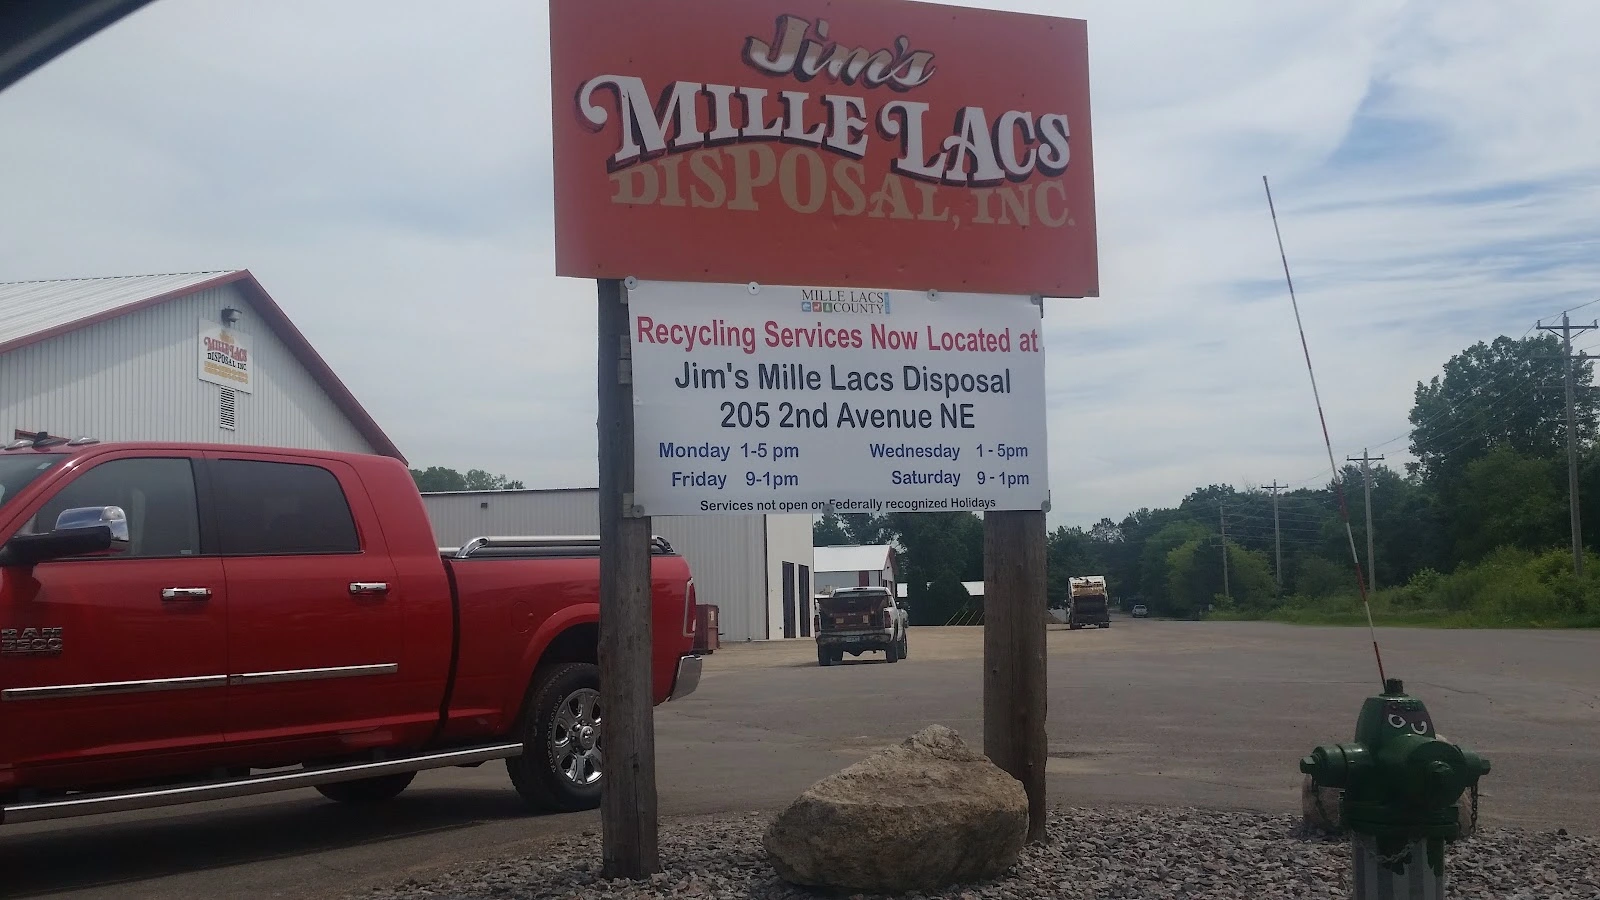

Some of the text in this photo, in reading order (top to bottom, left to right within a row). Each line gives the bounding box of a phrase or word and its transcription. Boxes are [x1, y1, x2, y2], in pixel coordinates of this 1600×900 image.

[742, 14, 936, 91] Jim's
[577, 74, 1073, 186] MILLE LACS
[972, 179, 1076, 228] INC.
[802, 289, 846, 302] MILLE
[850, 291, 884, 304] LACS
[833, 302, 884, 314] COUNTY
[637, 316, 1039, 354] Recycling Services Now Located at
[674, 362, 1011, 398] Jim's Mille Lacs Disposal
[720, 401, 975, 429] 205 2nd Avenue NE
[659, 442, 799, 462] Monday 1-5 pm
[870, 443, 960, 461] Wednesday
[997, 444, 1028, 460] 5pm
[672, 471, 799, 490] Friday 9-1pm
[892, 470, 961, 486] Saturday
[999, 471, 1029, 487] 1pm
[700, 500, 753, 511] Services
[757, 500, 776, 511] not
[779, 501, 808, 514] open
[811, 502, 825, 510] on
[885, 499, 947, 511] recognized
[951, 498, 996, 509] Holidays
[1, 626, 63, 639] RAM
